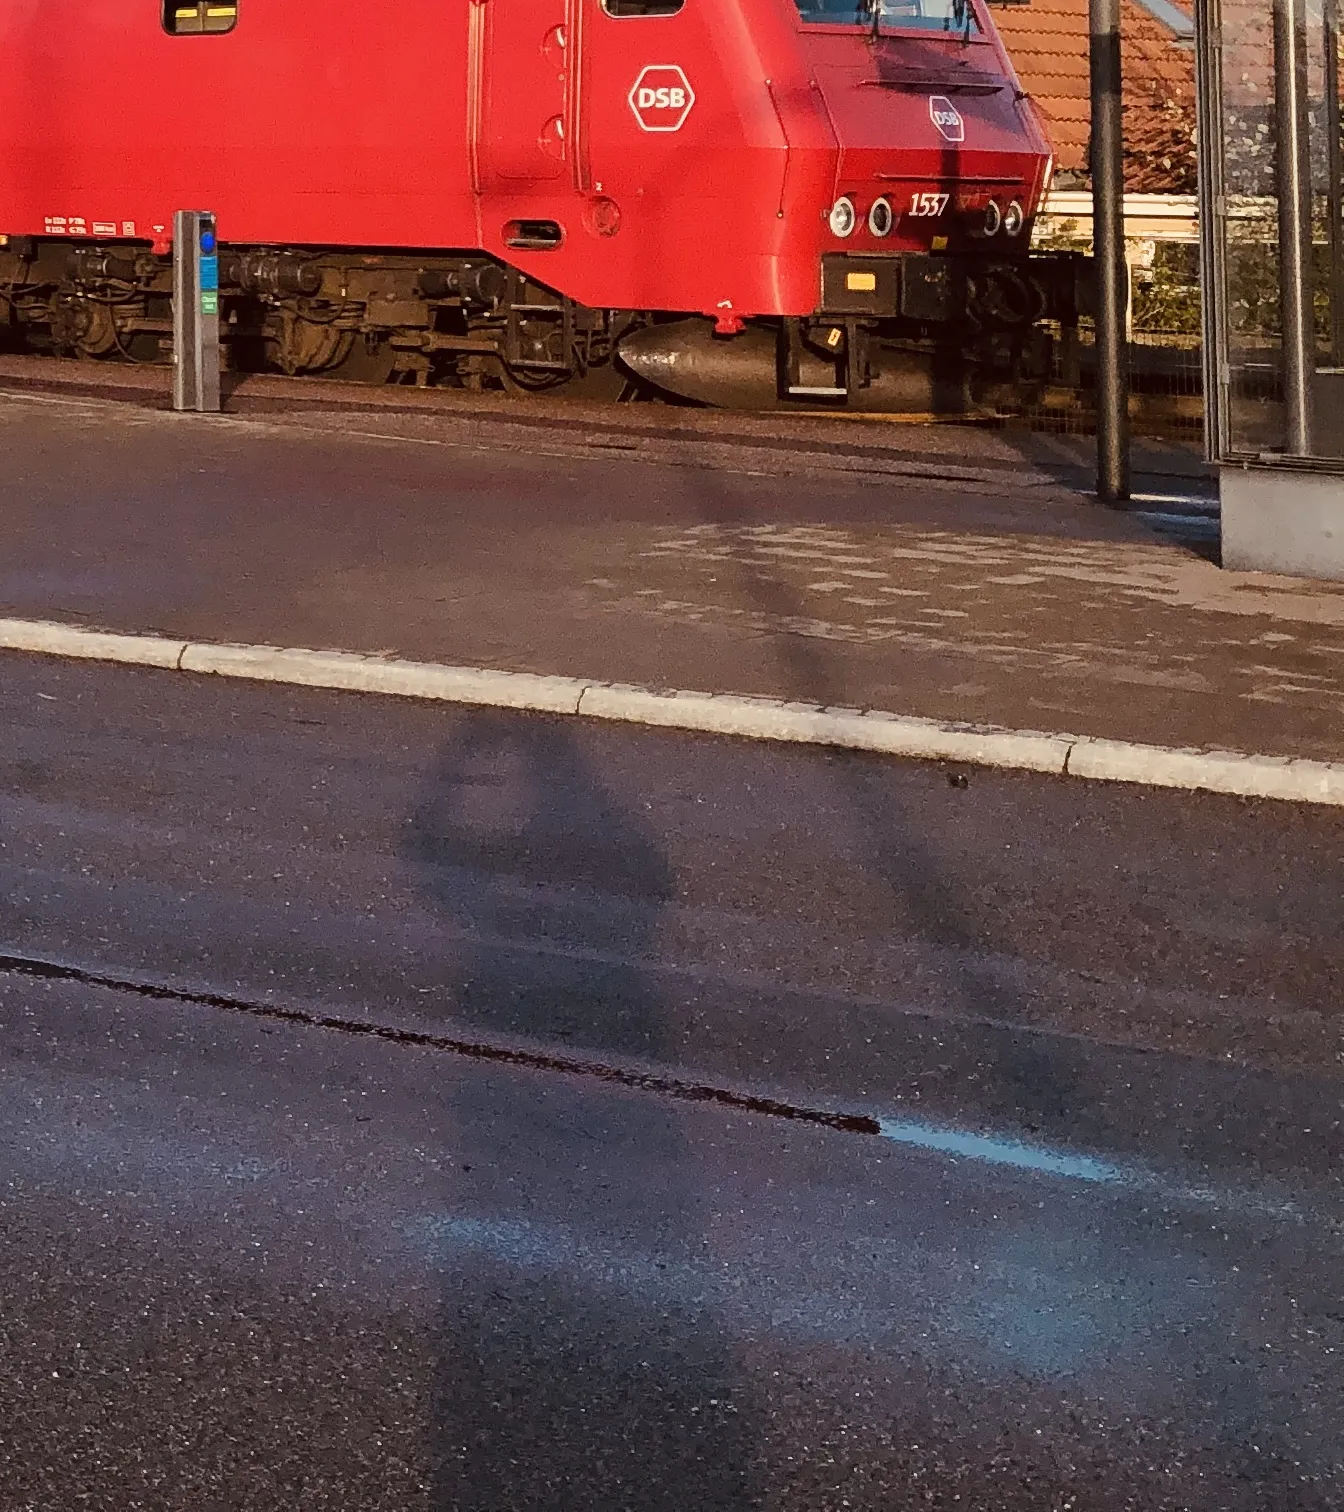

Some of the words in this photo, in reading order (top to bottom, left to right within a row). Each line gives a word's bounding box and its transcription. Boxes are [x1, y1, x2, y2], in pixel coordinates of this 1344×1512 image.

[638, 87, 686, 109] DSB
[933, 110, 960, 126] DSB
[908, 192, 950, 217] 1537
